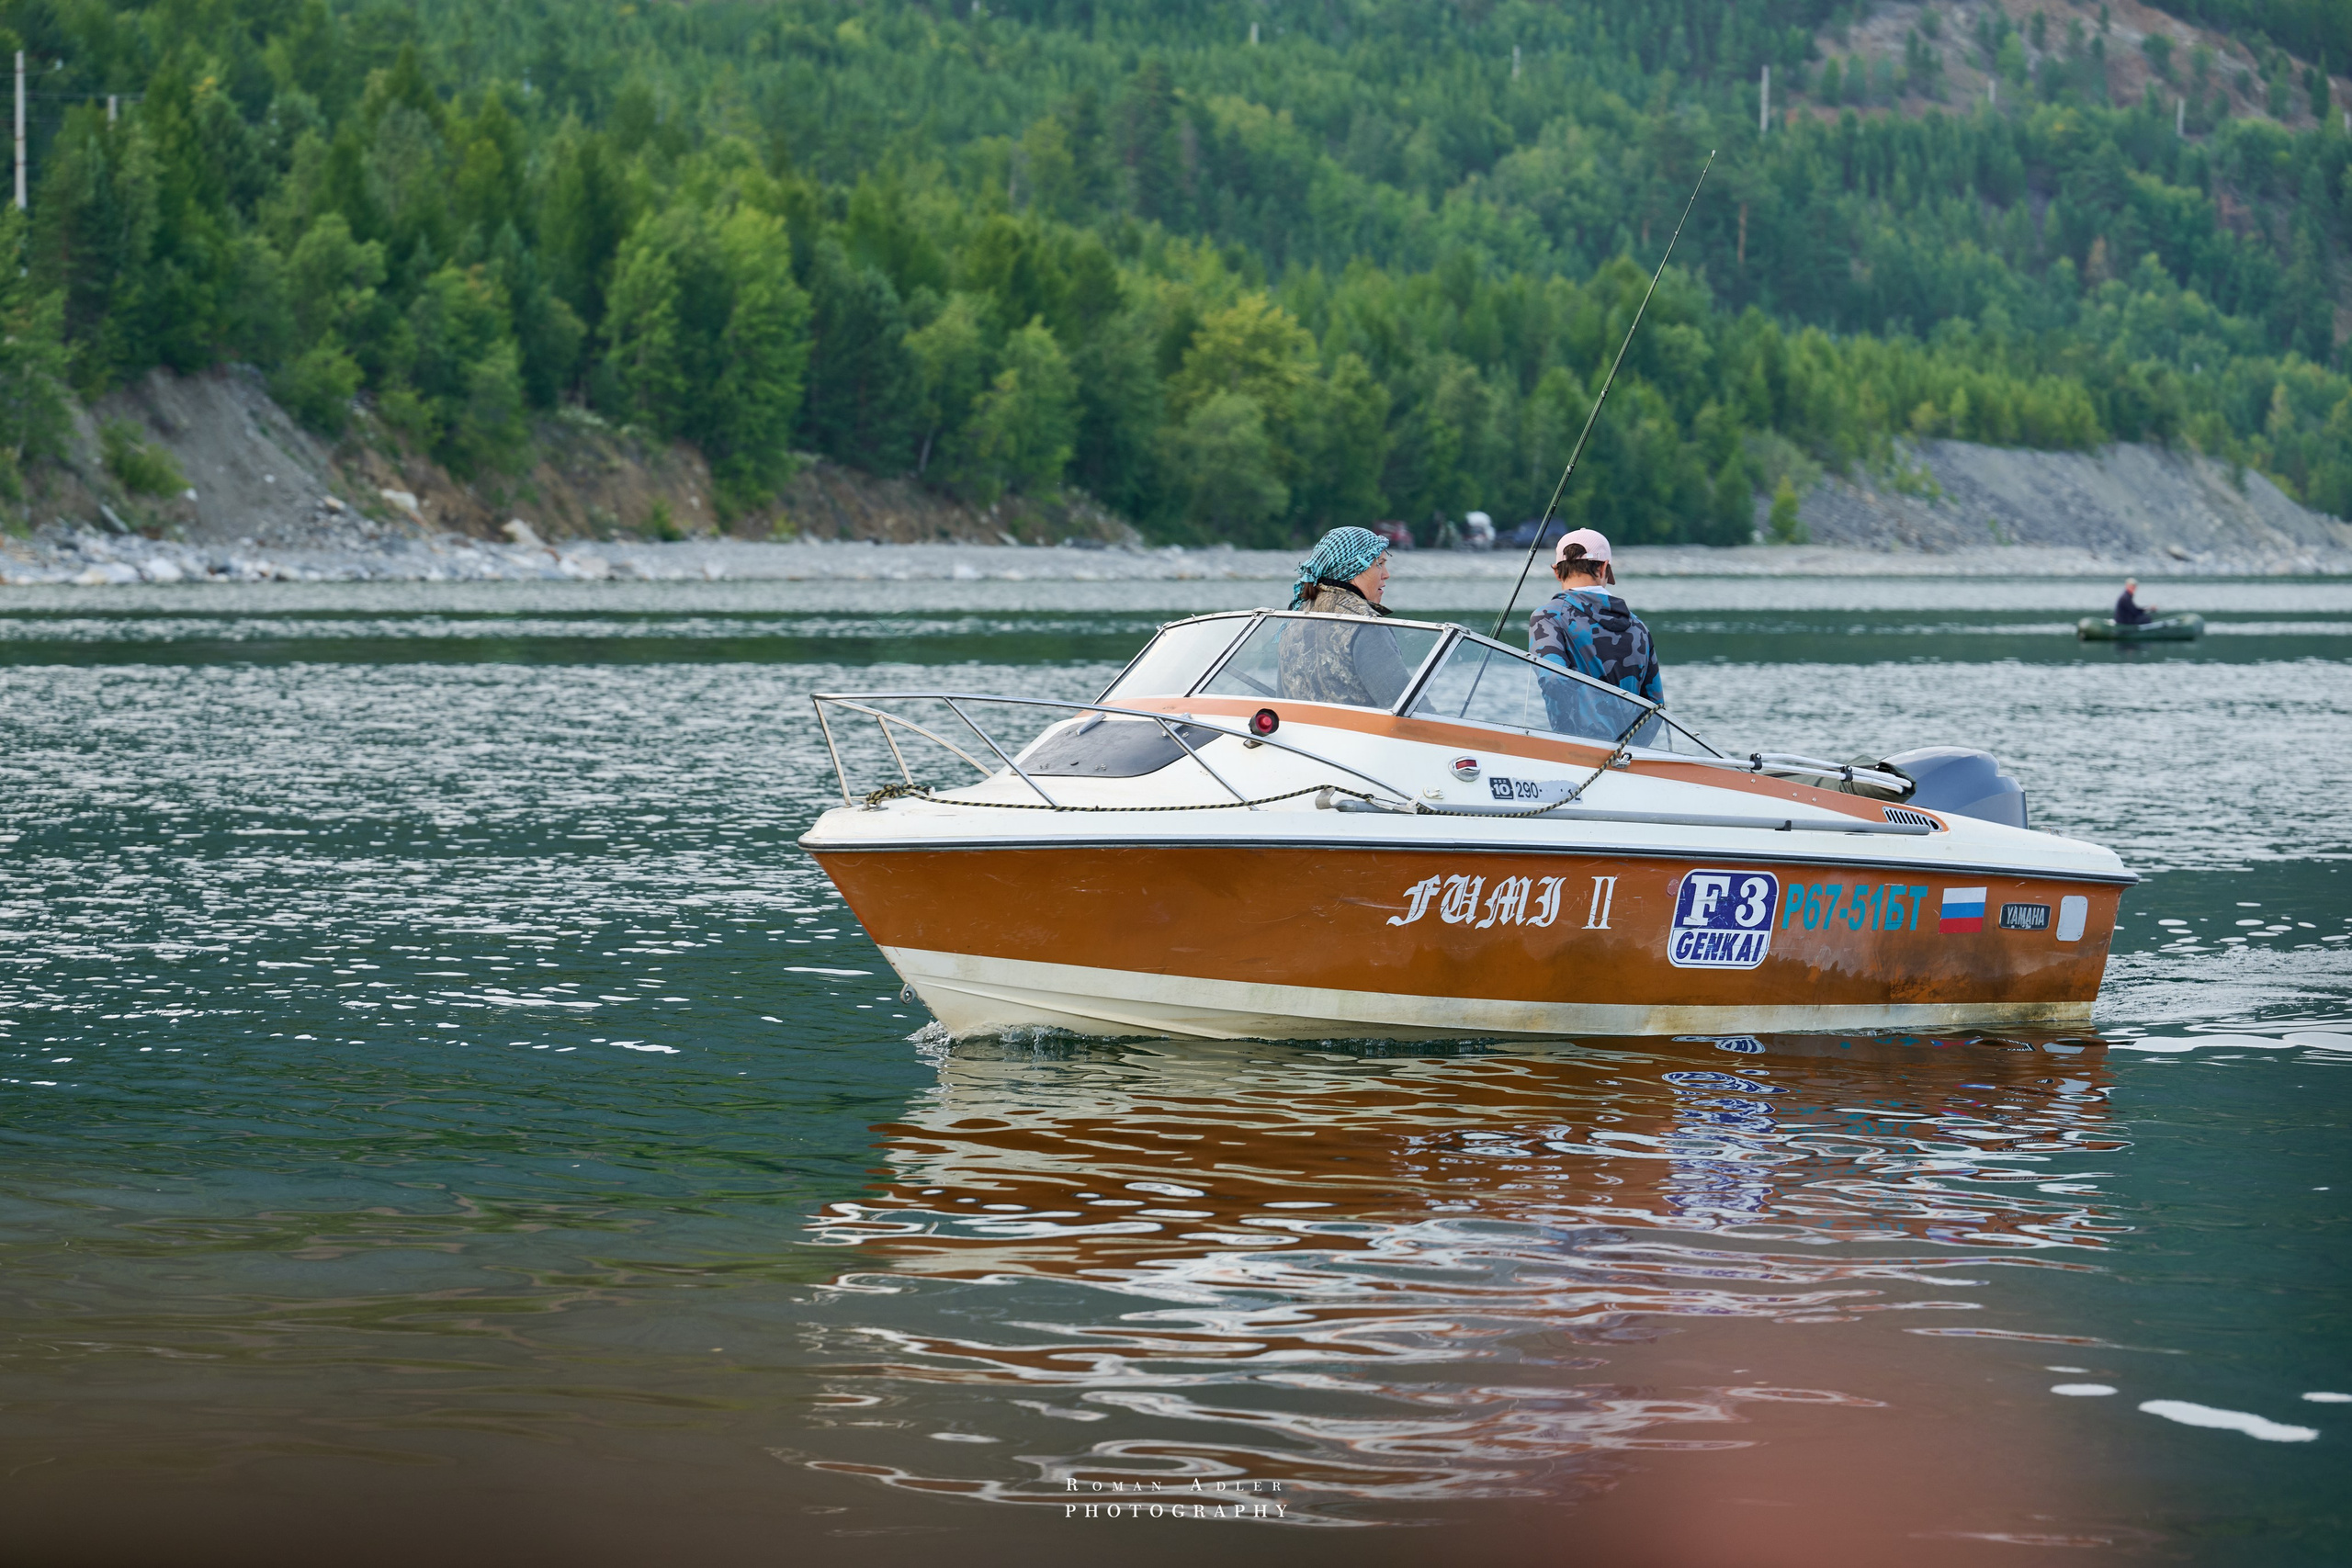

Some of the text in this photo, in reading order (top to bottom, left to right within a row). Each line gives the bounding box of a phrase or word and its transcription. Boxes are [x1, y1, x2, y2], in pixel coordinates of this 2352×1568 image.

[1493, 783, 1510, 795] 10
[2007, 906, 2045, 926] YAMAHA
[1675, 931, 1765, 964] GENKAI
